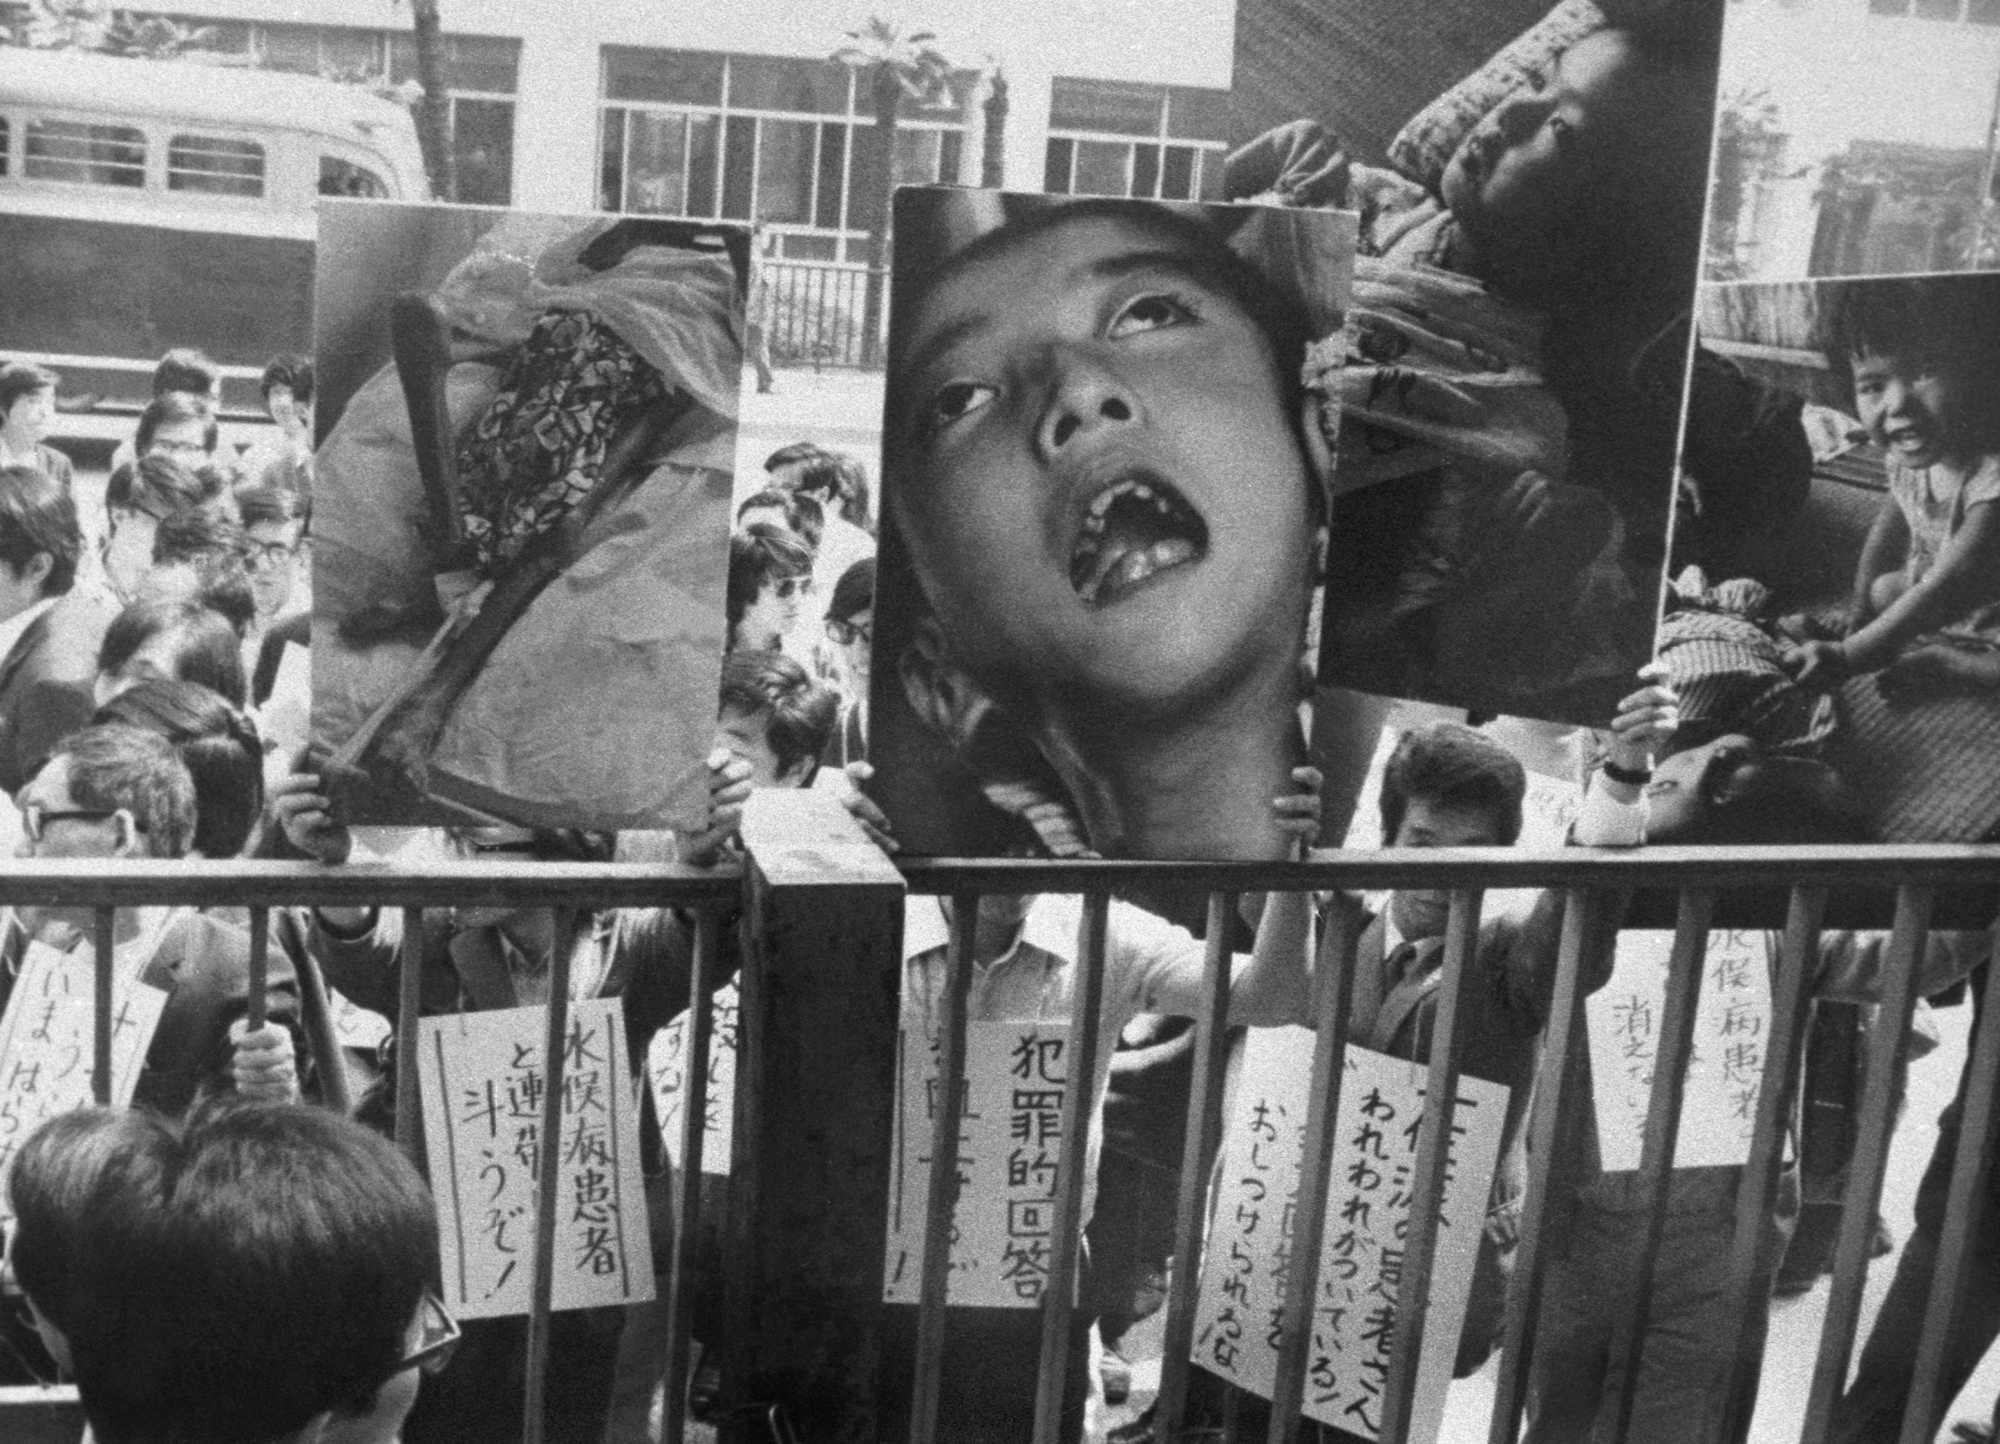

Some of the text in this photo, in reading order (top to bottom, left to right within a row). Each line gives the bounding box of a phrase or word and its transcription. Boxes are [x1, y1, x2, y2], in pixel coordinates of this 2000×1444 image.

[563, 1017, 615, 1276] 水俣病患者
[1000, 1031, 1067, 1299] 犯罪的回答
